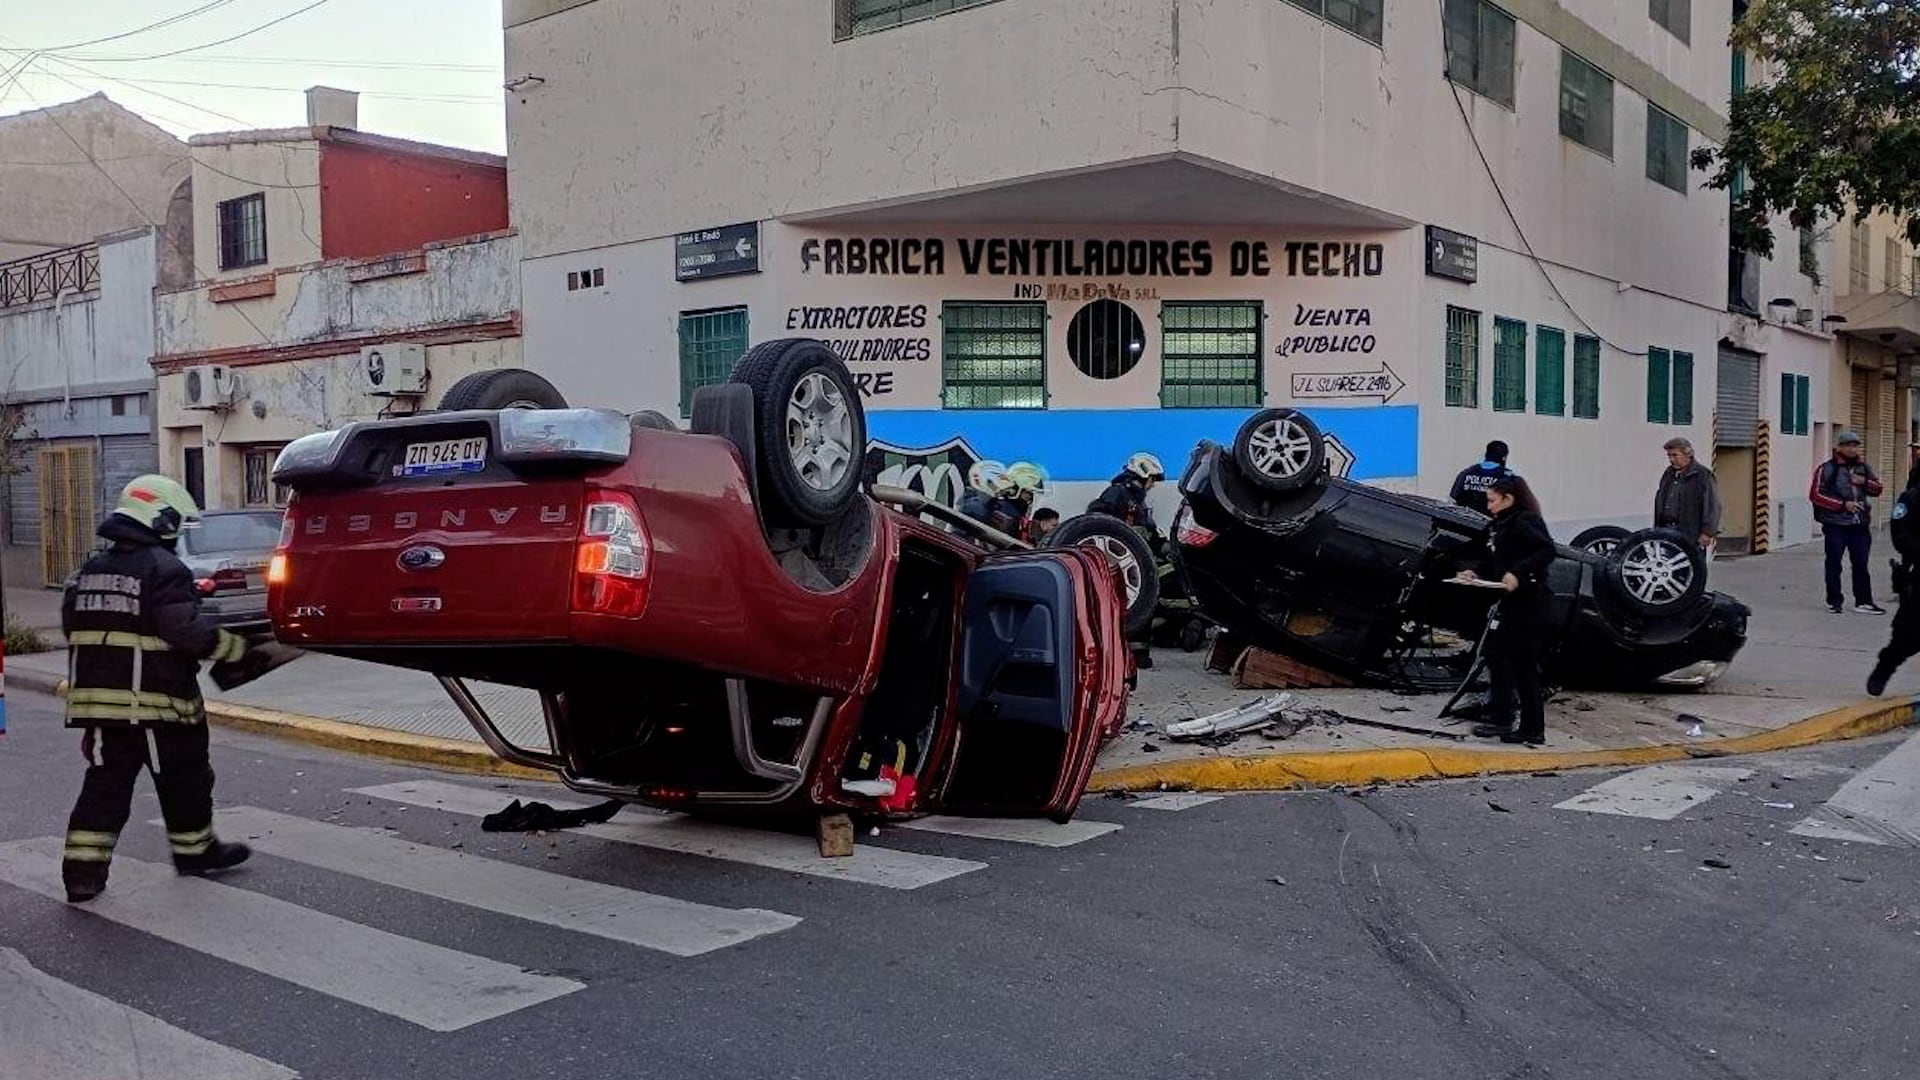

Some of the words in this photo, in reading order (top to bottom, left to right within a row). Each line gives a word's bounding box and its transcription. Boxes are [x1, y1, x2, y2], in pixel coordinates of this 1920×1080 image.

[801, 238, 944, 275] FABRICA
[957, 238, 1212, 277] VENTILADORES
[1230, 241, 1271, 277] DE
[1284, 241, 1384, 277] TECHO
[1014, 283, 1042, 298] IND
[786, 304, 927, 329] EXTRACTORES
[1294, 303, 1371, 326] VENTA
[823, 338, 931, 361] CULADORES
[1291, 335, 1377, 354] PUBLICO
[1316, 376, 1365, 392] SUAREZ
[305, 504, 567, 534] RANGER
